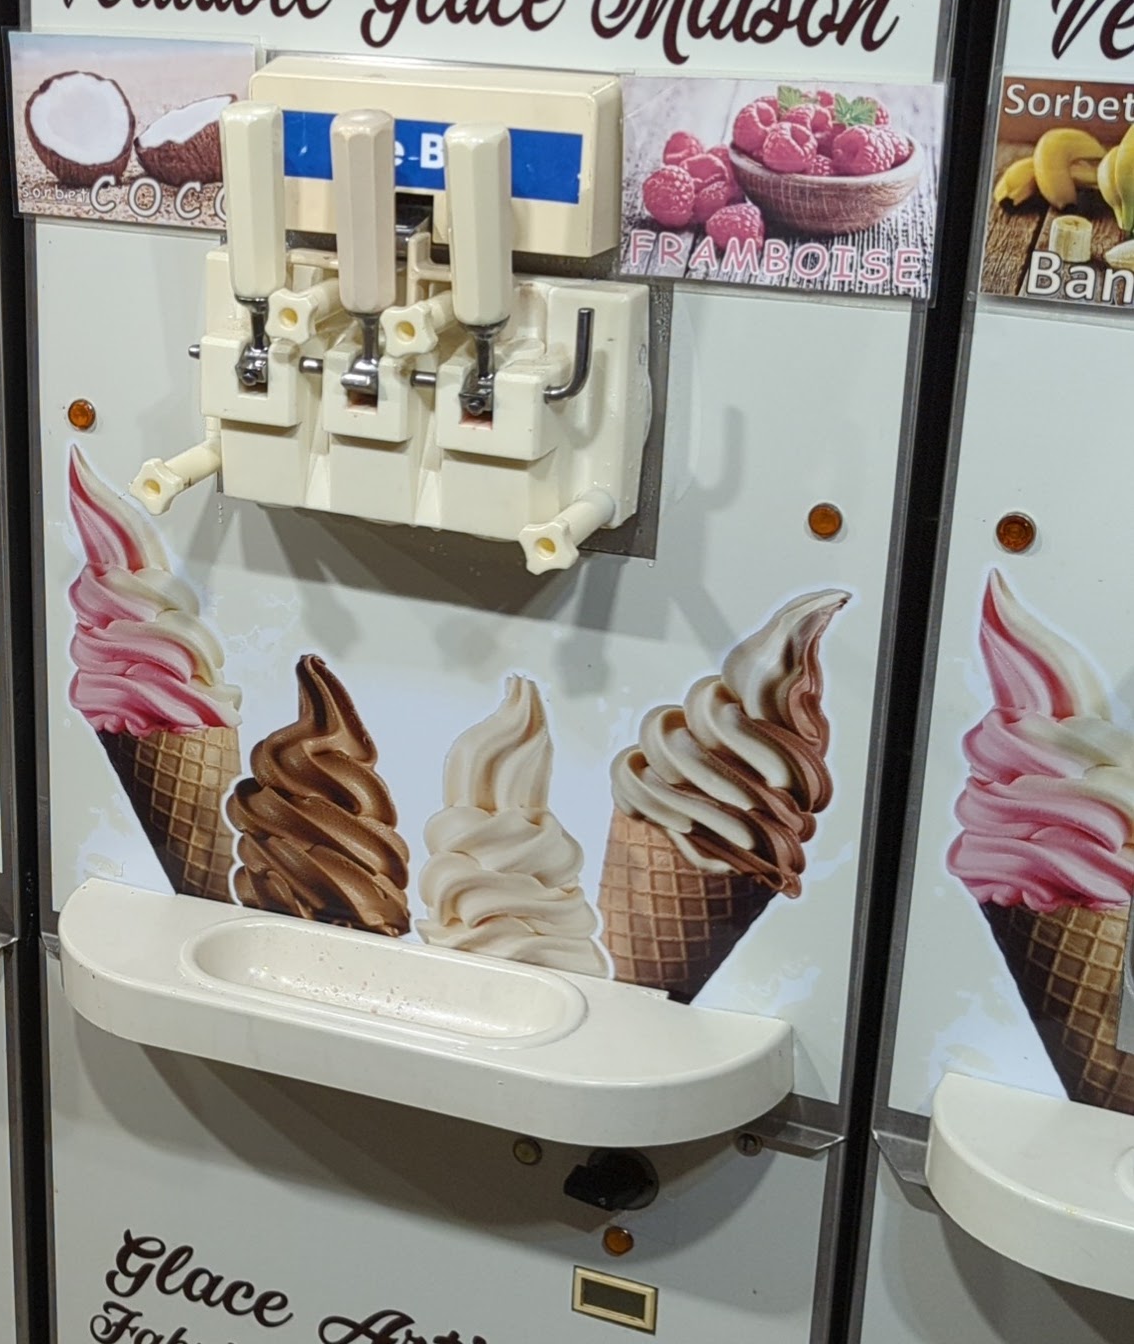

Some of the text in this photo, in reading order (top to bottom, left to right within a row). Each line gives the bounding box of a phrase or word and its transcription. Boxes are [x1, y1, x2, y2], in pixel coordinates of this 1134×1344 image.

[1004, 84, 1134, 123] Sorbet
[22, 185, 89, 203] sorbet
[629, 229, 922, 290] FRAMBOISE
[105, 1229, 293, 1328] Glace
